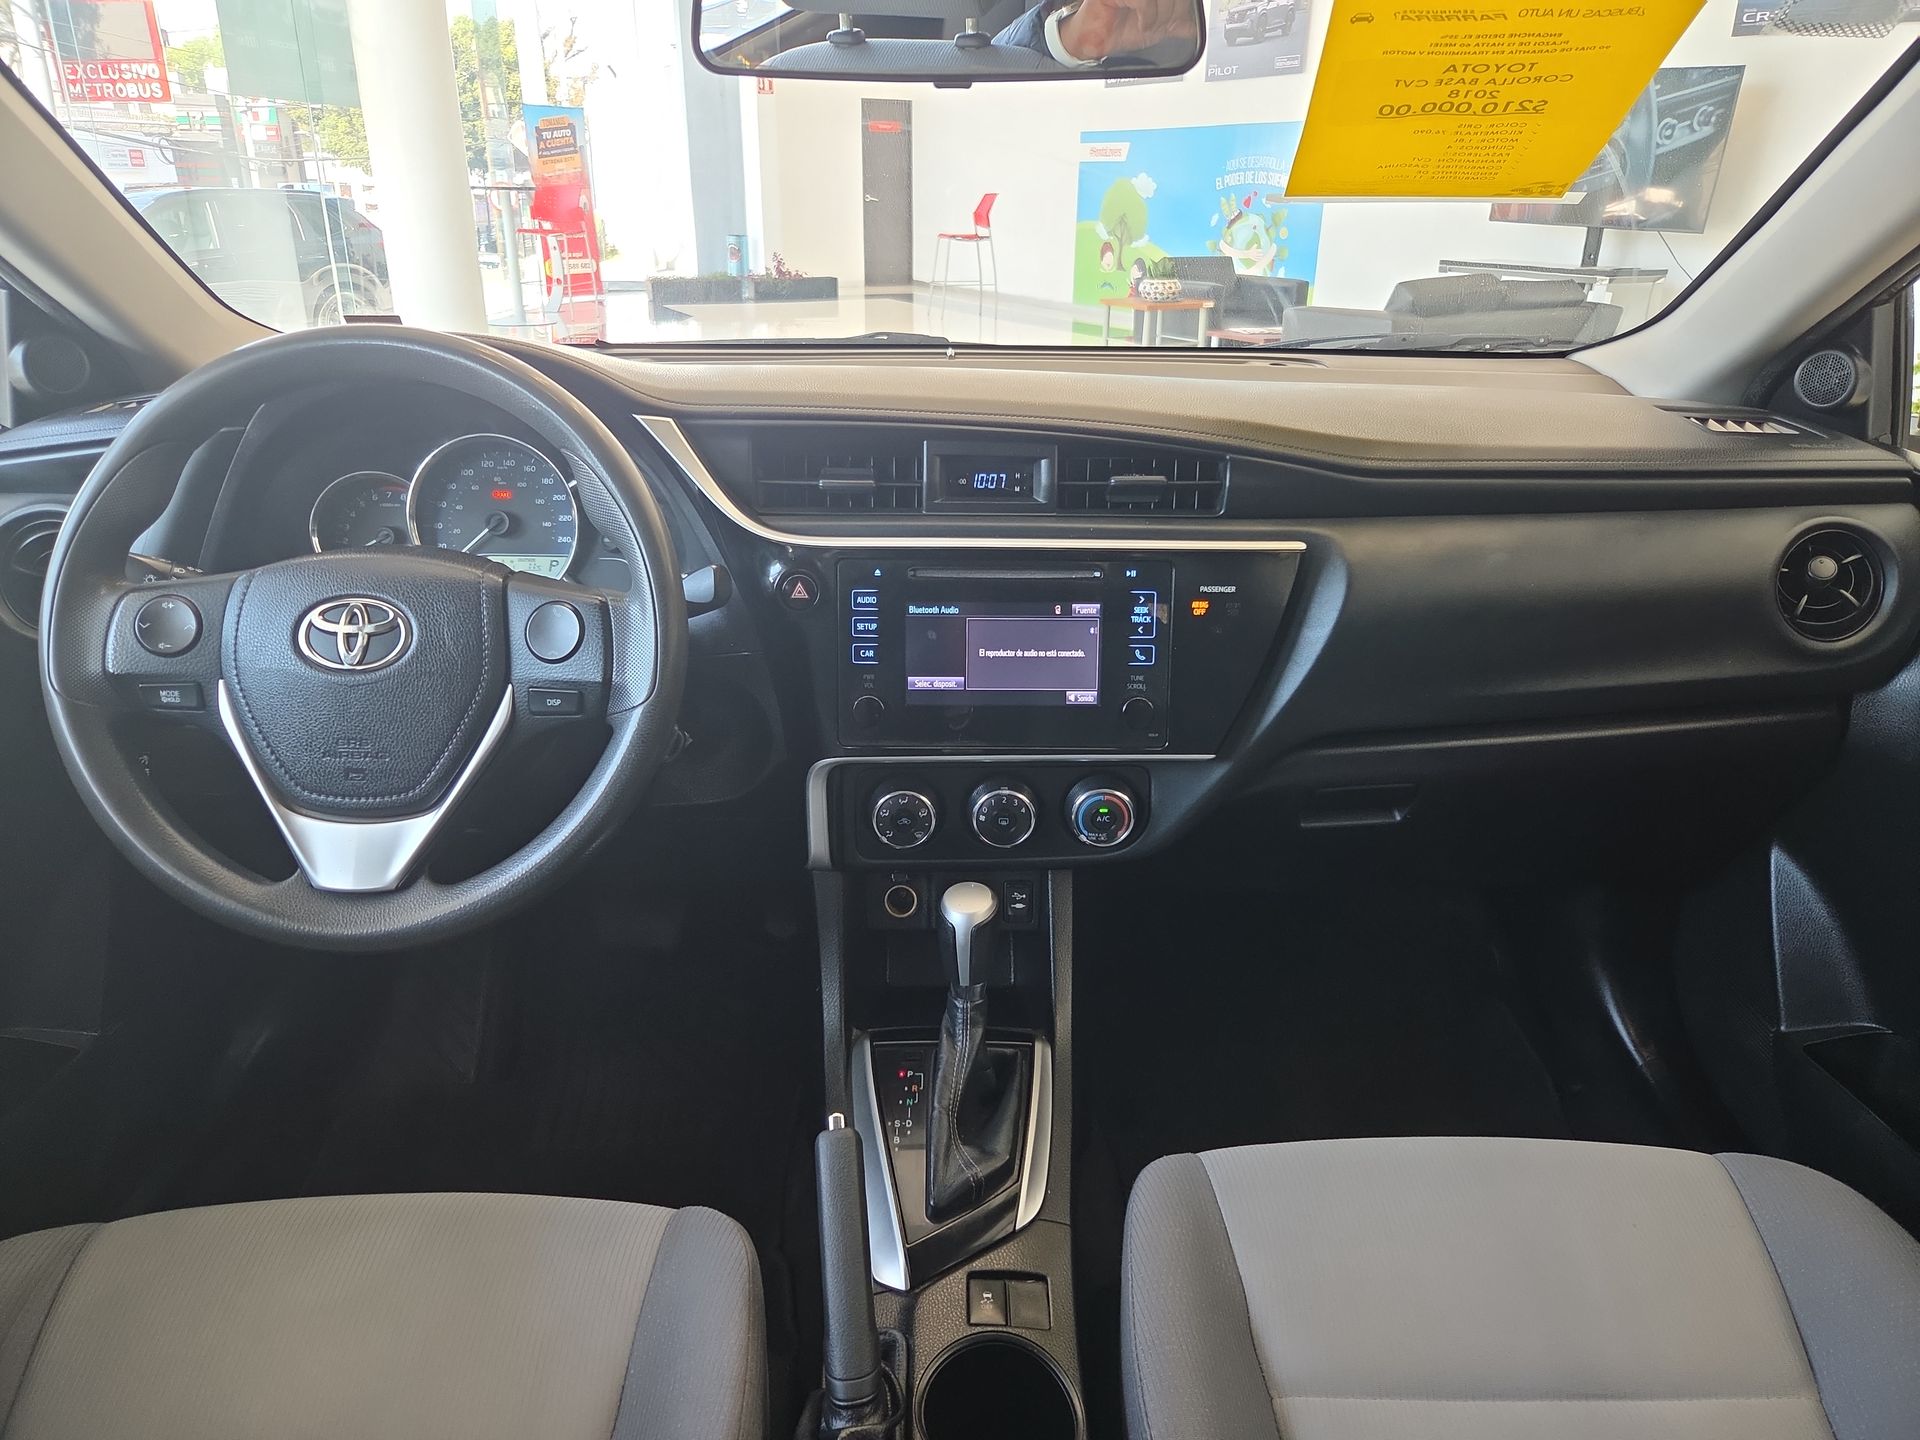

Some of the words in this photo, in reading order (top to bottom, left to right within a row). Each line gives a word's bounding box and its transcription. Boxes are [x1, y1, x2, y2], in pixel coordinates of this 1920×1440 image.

[64, 62, 160, 80] EXCLUSIVO
[1208, 65, 1239, 76] PILOT
[69, 81, 164, 99] METROBUS
[541, 131, 552, 140] TU
[553, 129, 572, 139] AUTO
[1215, 176, 1224, 190] EL
[1224, 172, 1246, 188] PODER
[1245, 171, 1255, 185] DE
[1255, 171, 1268, 185] LOS
[481, 460, 494, 468] 120
[503, 459, 516, 467] 140
[523, 465, 537, 473] 160
[973, 473, 1007, 489] 10:07
[558, 514, 573, 522] 220
[549, 559, 560, 572] P
[856, 596, 877, 604] AUDIO
[908, 605, 940, 614] Bluetooth
[940, 605, 960, 614] Audio
[1075, 606, 1097, 615] Fuente
[1133, 606, 1149, 614] SEEK
[1193, 608, 1206, 616] OFF
[1130, 615, 1151, 623] TRACK
[856, 623, 878, 631] SETUP
[860, 650, 874, 658] CAR
[979, 648, 985, 657] El
[985, 648, 1015, 659] reproductor
[1015, 648, 1023, 657] de
[1023, 648, 1038, 657] audio
[1057, 648, 1086, 657] conectado.
[914, 680, 932, 688] Selec.
[933, 680, 958, 689] disposit.
[160, 690, 180, 698] MODE
[1076, 694, 1095, 702] Sonido
[546, 698, 562, 706] DISP
[907, 1070, 914, 1078] P
[911, 1084, 918, 1092] R
[906, 1098, 913, 1106] N
[894, 1120, 901, 1128] S
[905, 1120, 913, 1128] D
[893, 1136, 901, 1144] B
